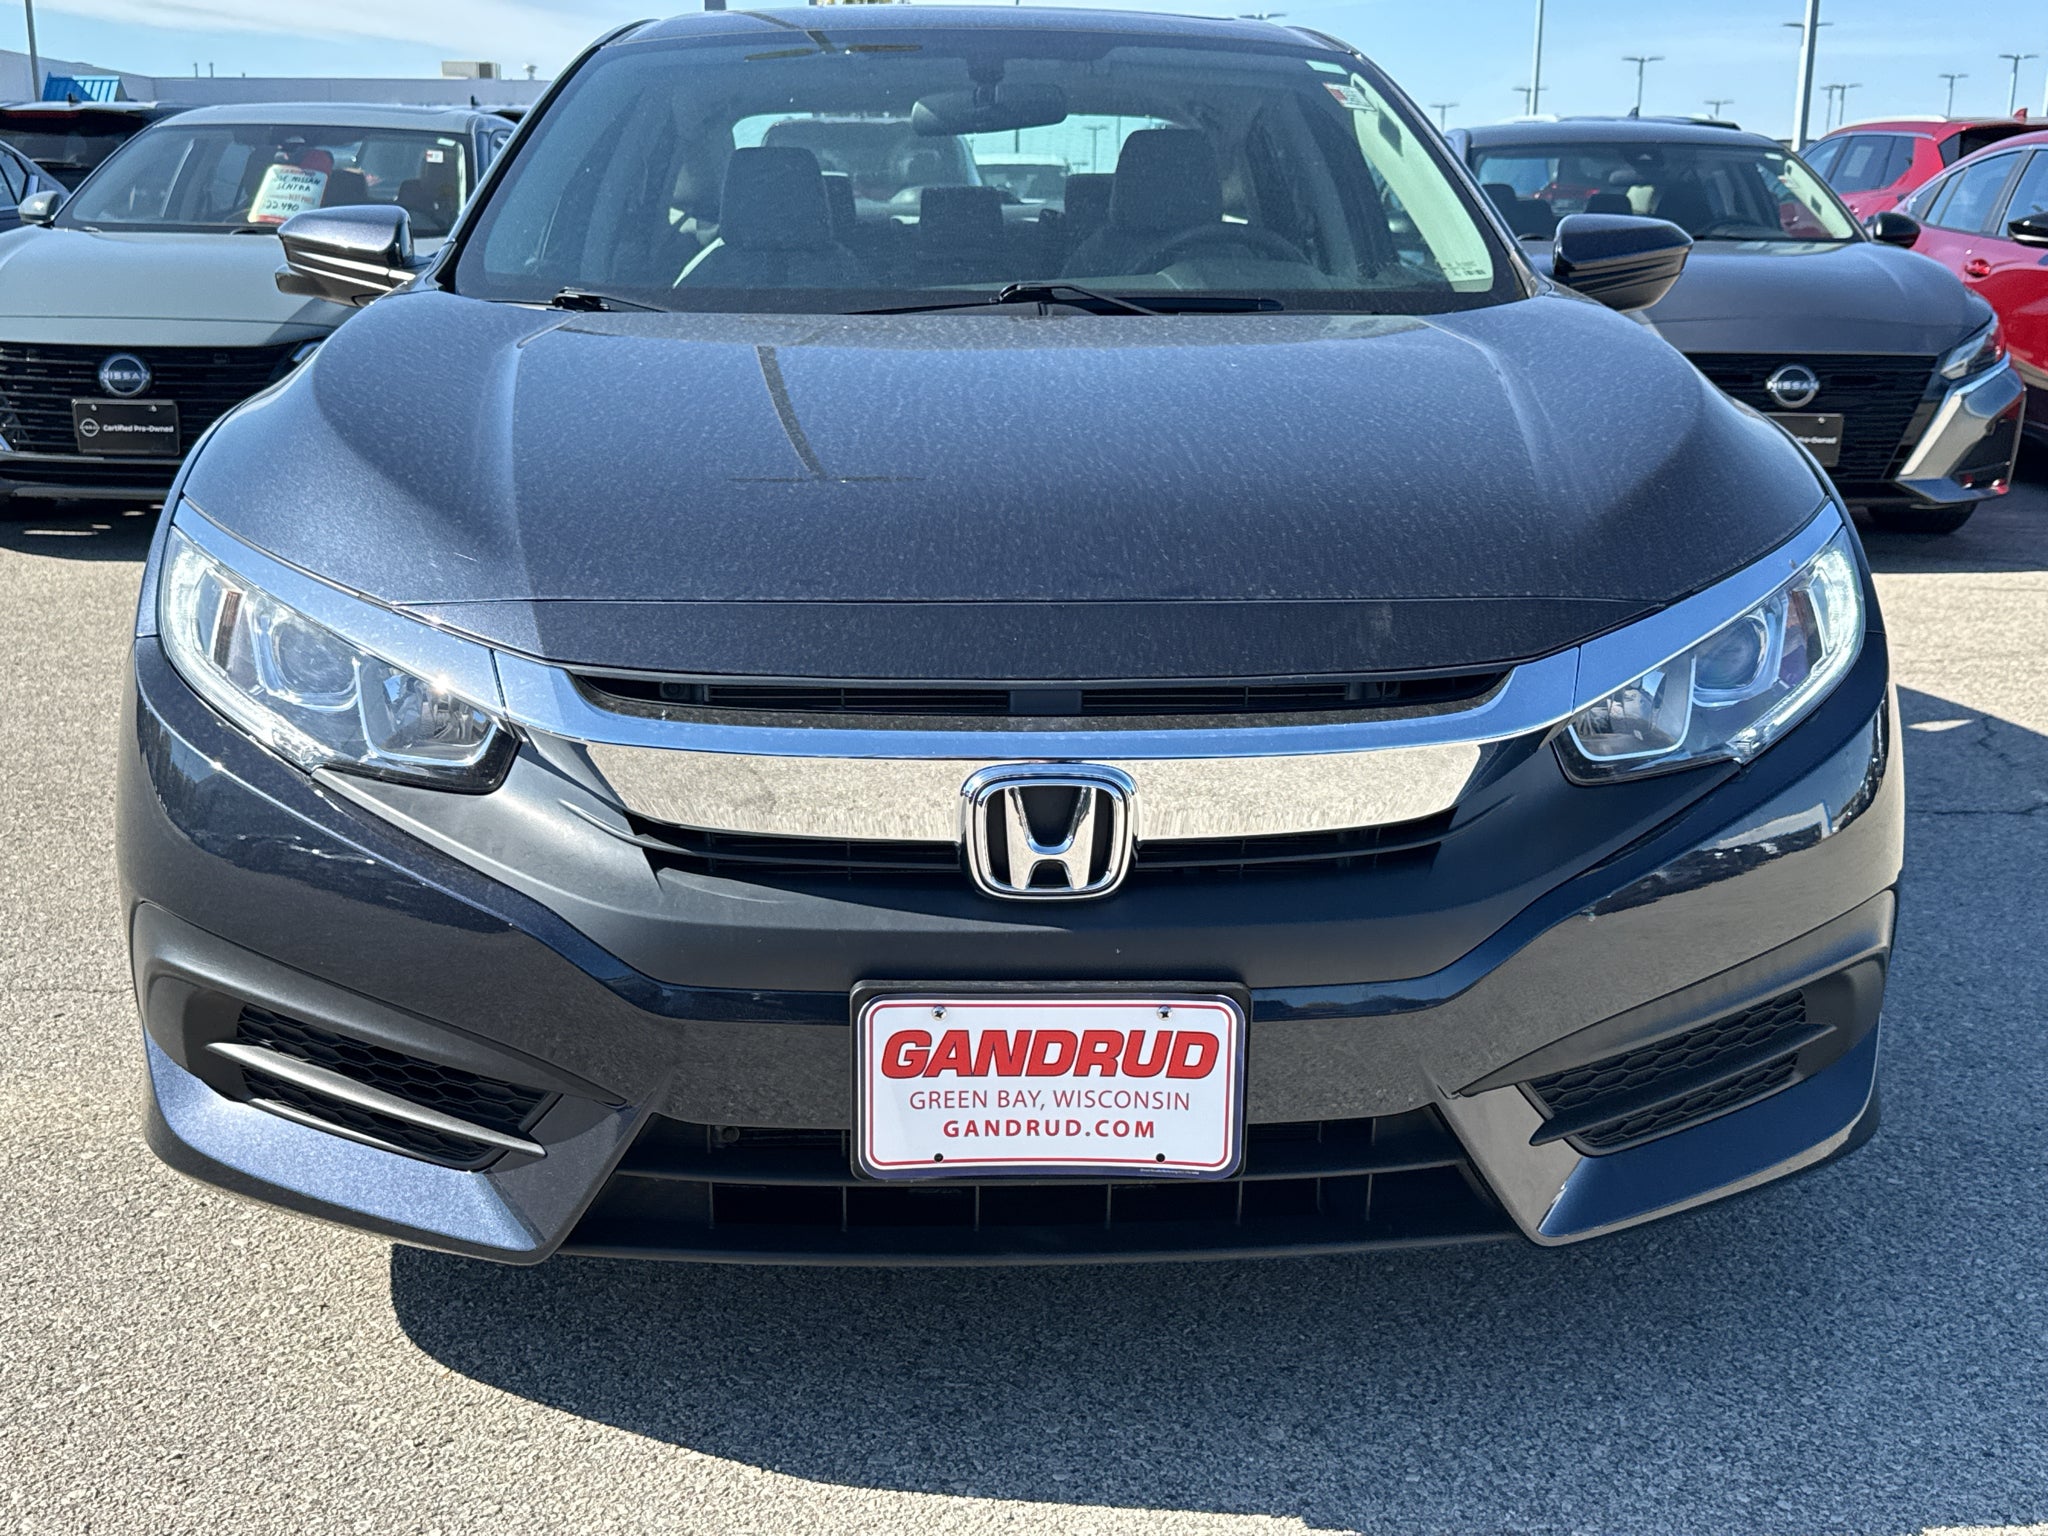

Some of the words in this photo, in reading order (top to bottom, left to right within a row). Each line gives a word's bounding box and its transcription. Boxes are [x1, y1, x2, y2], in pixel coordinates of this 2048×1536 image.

[100, 370, 150, 380] NISSAN
[1766, 380, 1819, 391] NISSAN
[103, 424, 133, 433] Certified
[133, 424, 174, 433] Pre-Owned
[881, 1029, 1220, 1079] GANDRUD
[909, 1090, 988, 1110] GREEN
[997, 1089, 1046, 1111] BAY,
[1052, 1089, 1190, 1111] WISCONSIN
[943, 1119, 1155, 1138] GANDRUD.COM
